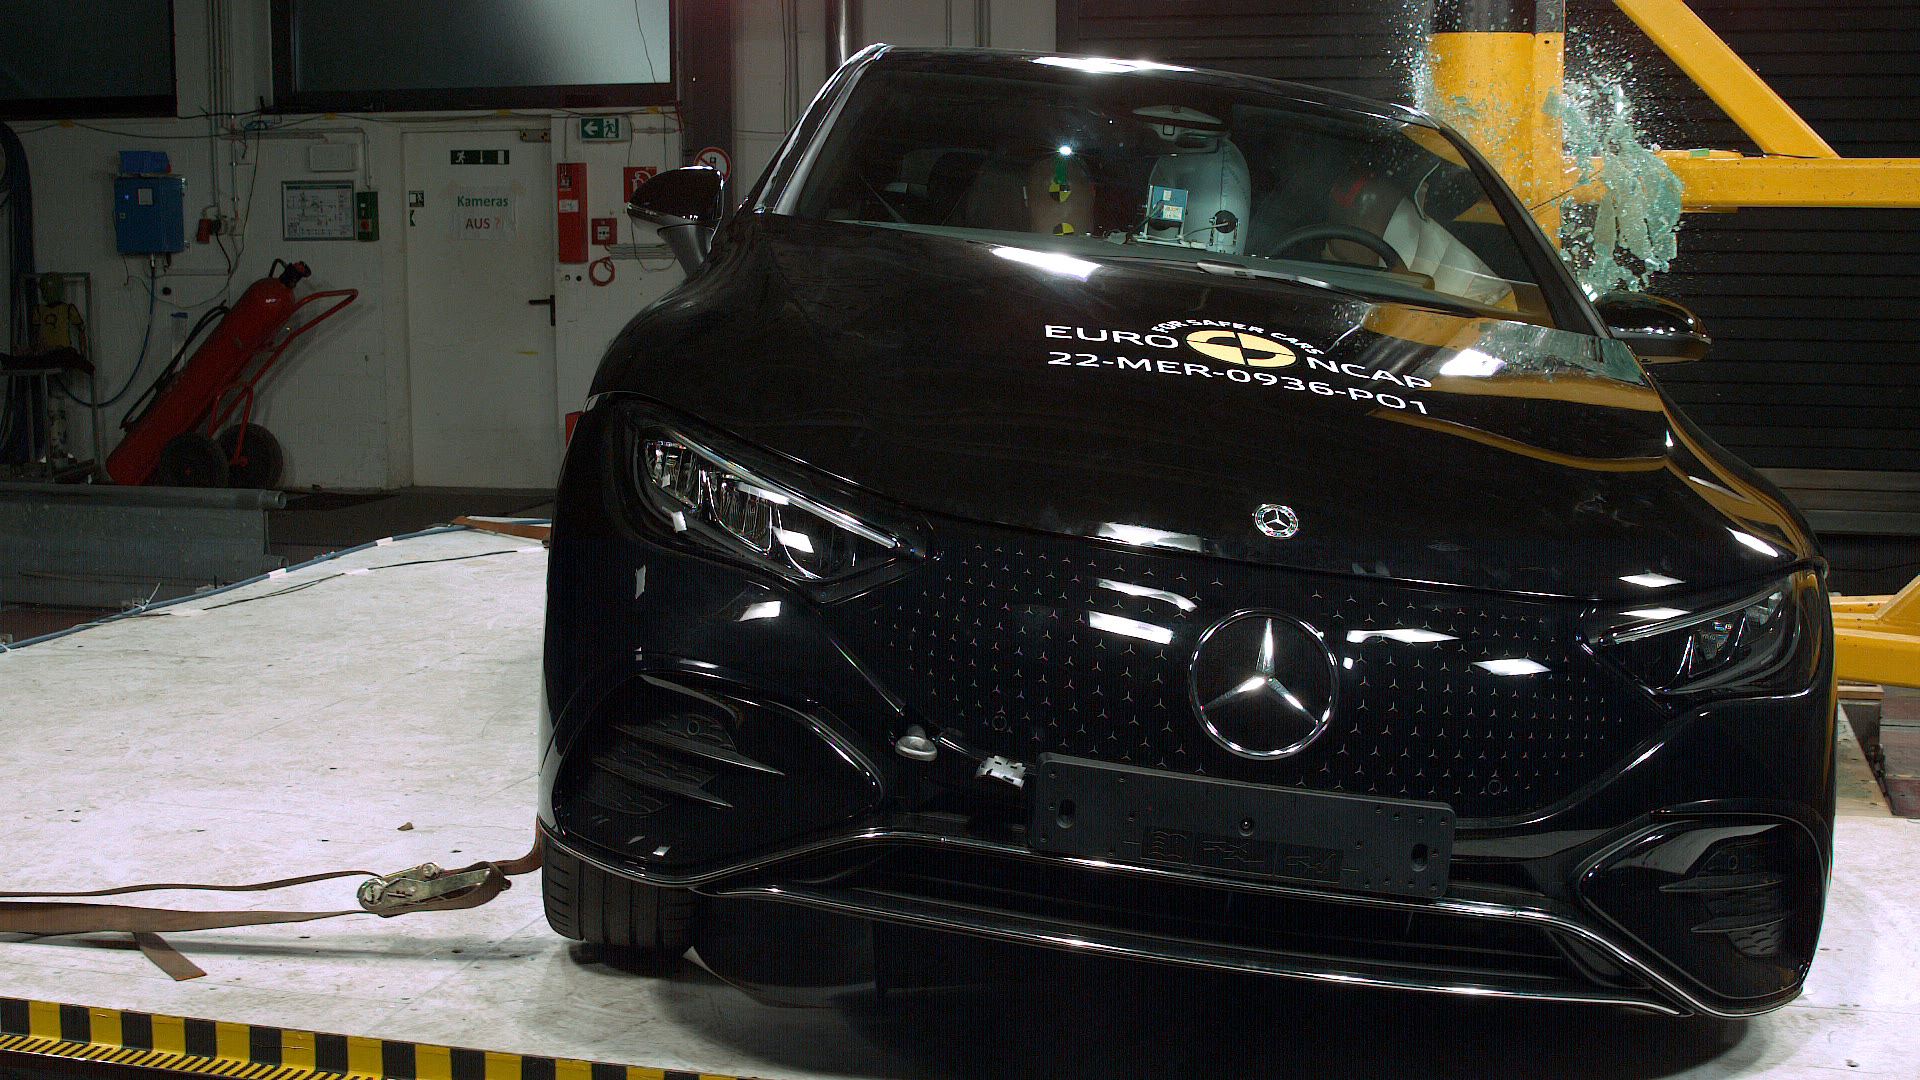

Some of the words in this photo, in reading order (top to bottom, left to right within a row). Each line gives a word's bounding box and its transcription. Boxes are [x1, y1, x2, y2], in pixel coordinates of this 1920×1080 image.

[457, 195, 509, 207] Kameras
[465, 218, 490, 230] AUS
[1151, 320, 1188, 334] FOR
[1186, 319, 1264, 334] SAFER
[1270, 332, 1325, 355] CARS
[1044, 324, 1179, 349] EURO
[1306, 356, 1432, 389] NCAP
[1047, 351, 1429, 415] 22-MER-0936-P01
